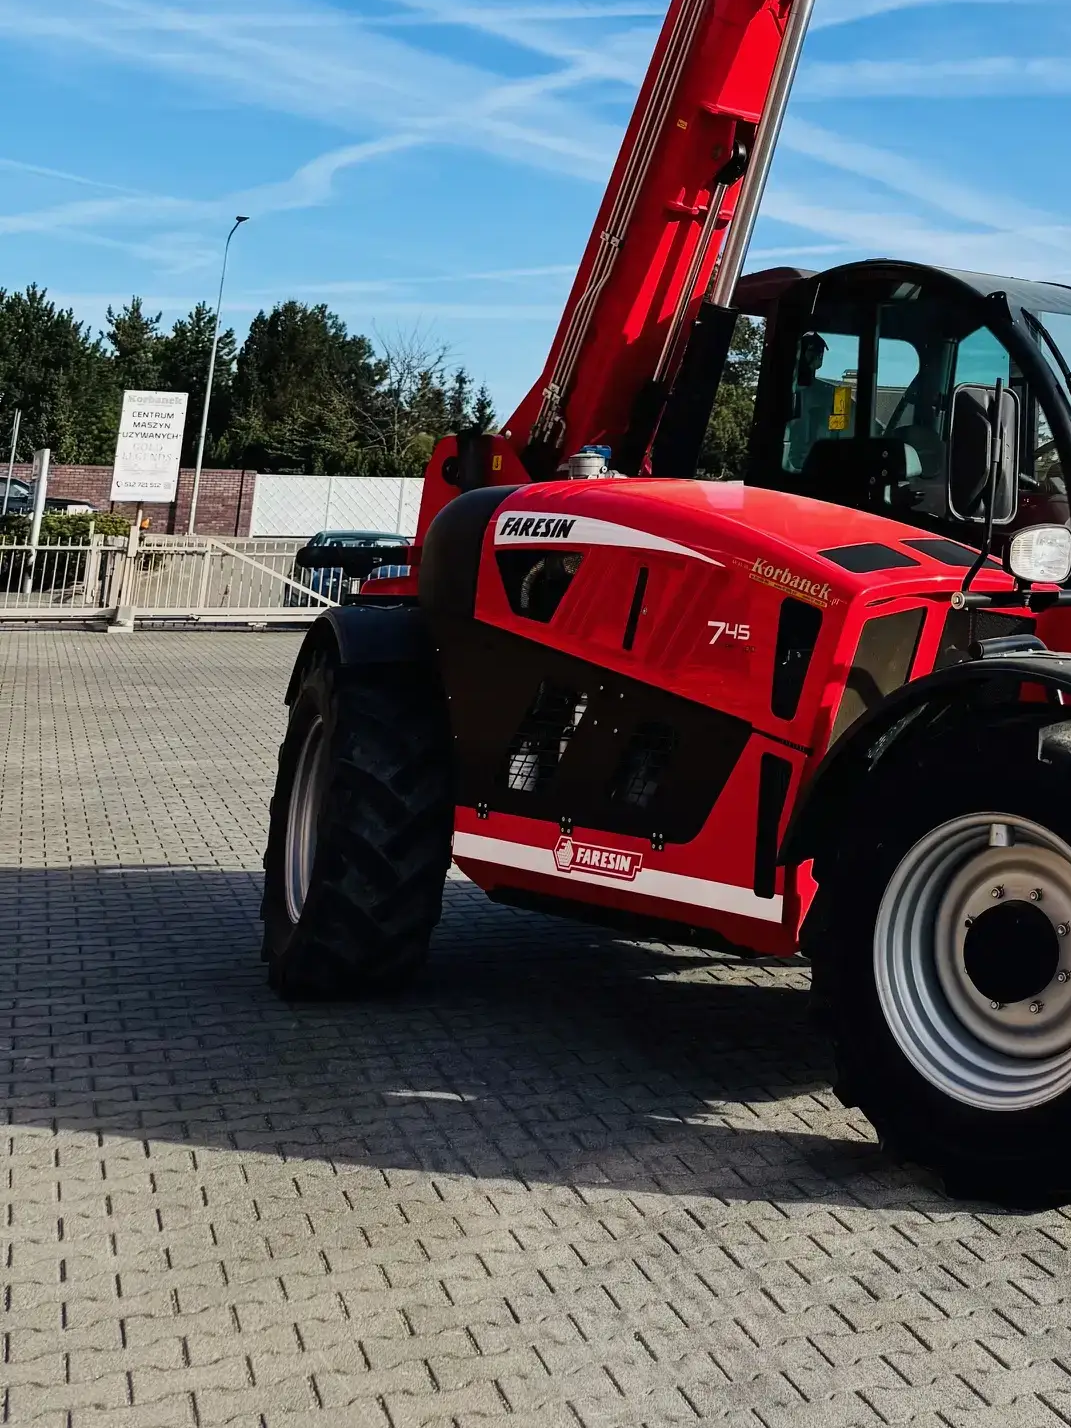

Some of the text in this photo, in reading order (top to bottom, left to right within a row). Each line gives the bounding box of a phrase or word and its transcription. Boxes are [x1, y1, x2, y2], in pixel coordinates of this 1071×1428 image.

[132, 411, 174, 419] CENTRUM
[133, 421, 170, 429] MASZYN
[499, 517, 577, 539] FARESIN
[707, 620, 750, 645] 745
[575, 847, 631, 872] FARESIN
